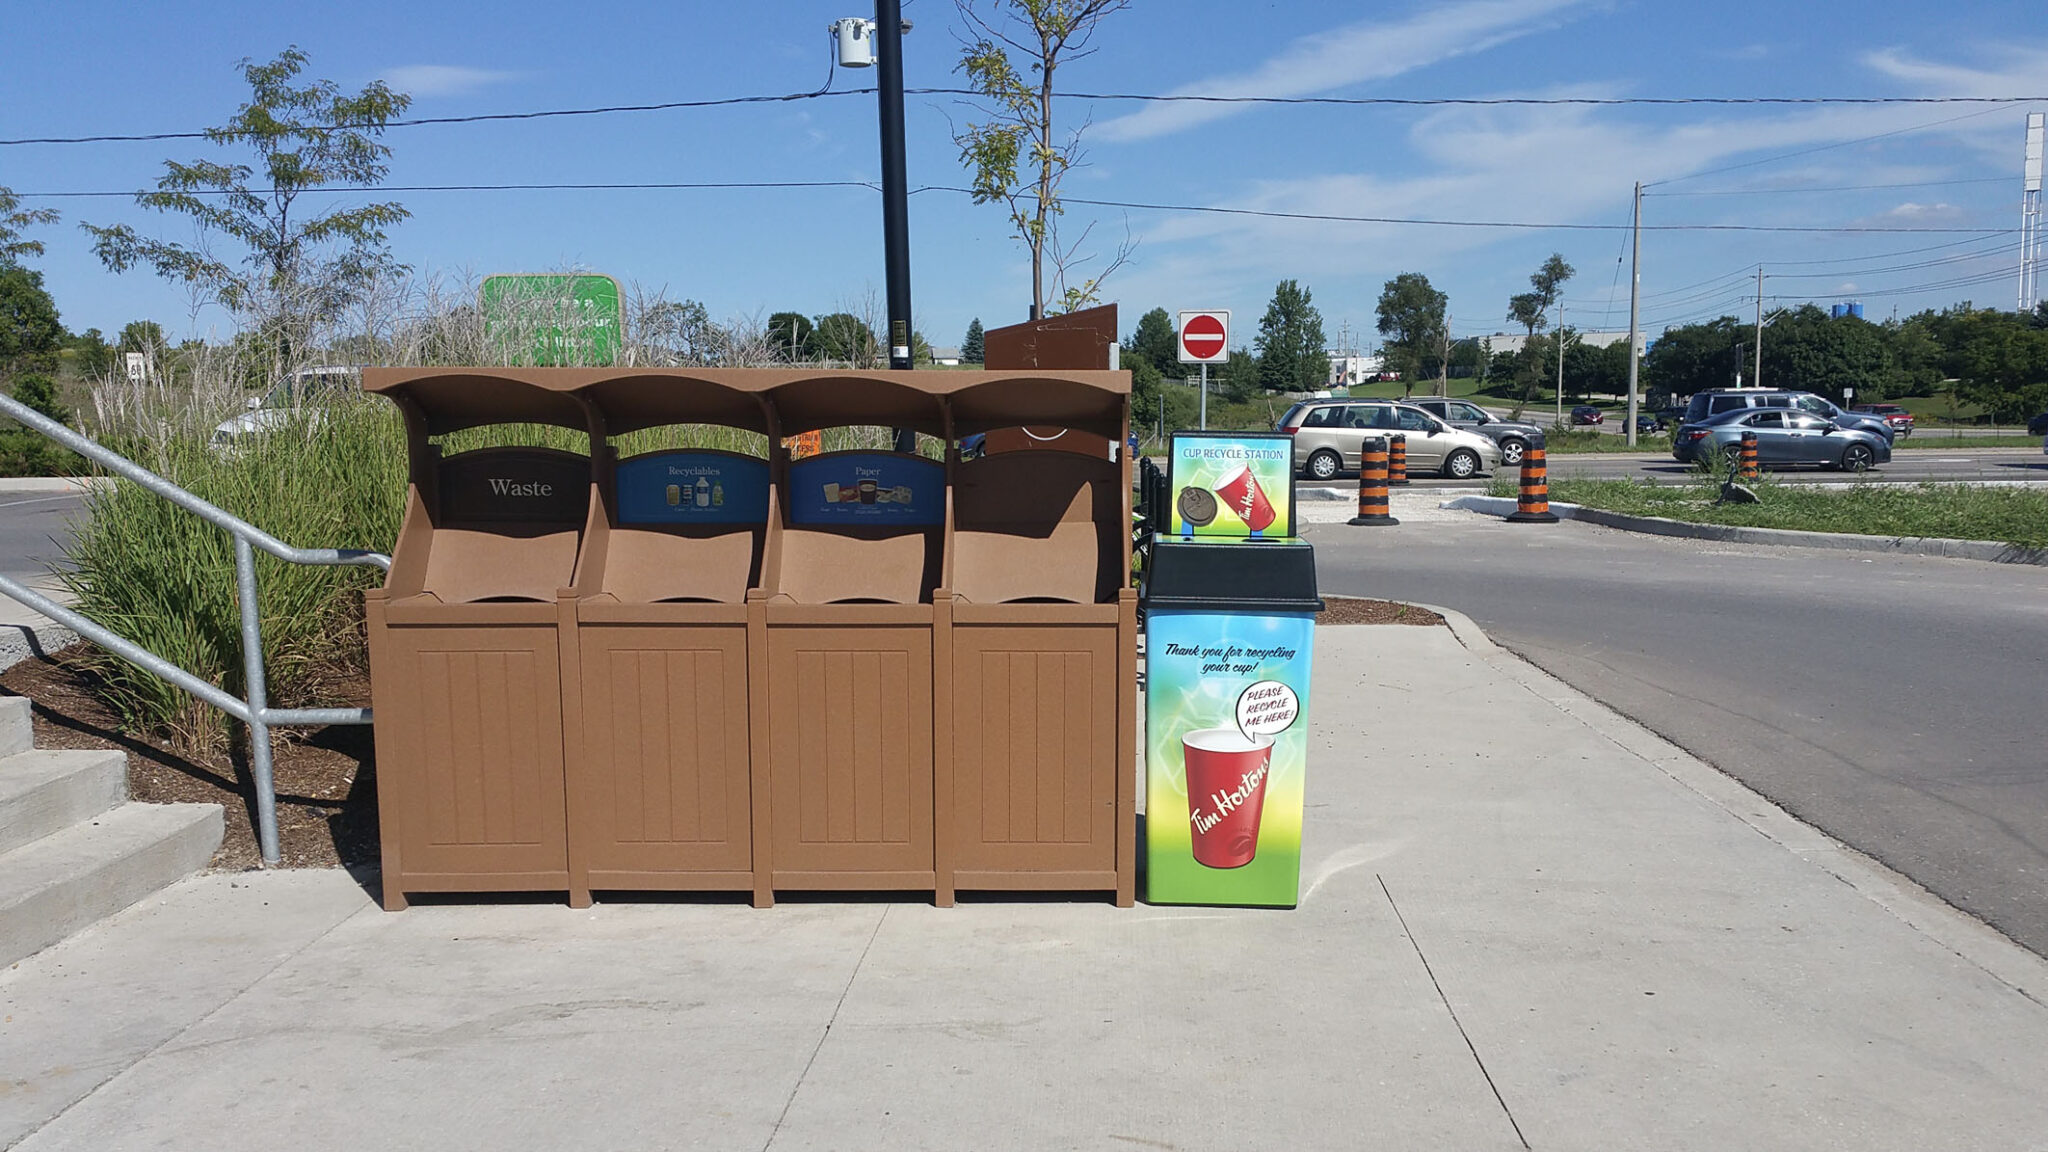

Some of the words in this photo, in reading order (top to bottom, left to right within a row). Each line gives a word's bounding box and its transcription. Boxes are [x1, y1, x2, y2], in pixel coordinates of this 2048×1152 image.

[1183, 449, 1201, 458] CUP
[1204, 449, 1241, 459] RECYCLE
[1244, 450, 1284, 459] STATION
[668, 465, 720, 477] Recyclables
[855, 466, 881, 476] Paper
[488, 479, 552, 497] Waste
[1238, 509, 1252, 521] Tim
[1165, 643, 1199, 656] Thank
[1200, 647, 1223, 660] you
[1222, 645, 1242, 662] for
[1245, 647, 1296, 660] recycling
[1200, 662, 1230, 674] your
[1232, 662, 1259, 675] cup!
[1247, 686, 1284, 701] PLEASE
[1246, 698, 1289, 714] RECYCLE
[1245, 715, 1262, 727] ME
[1263, 710, 1294, 724] HERE!
[1191, 808, 1222, 835] Tim
[1211, 756, 1269, 817] Hortons
